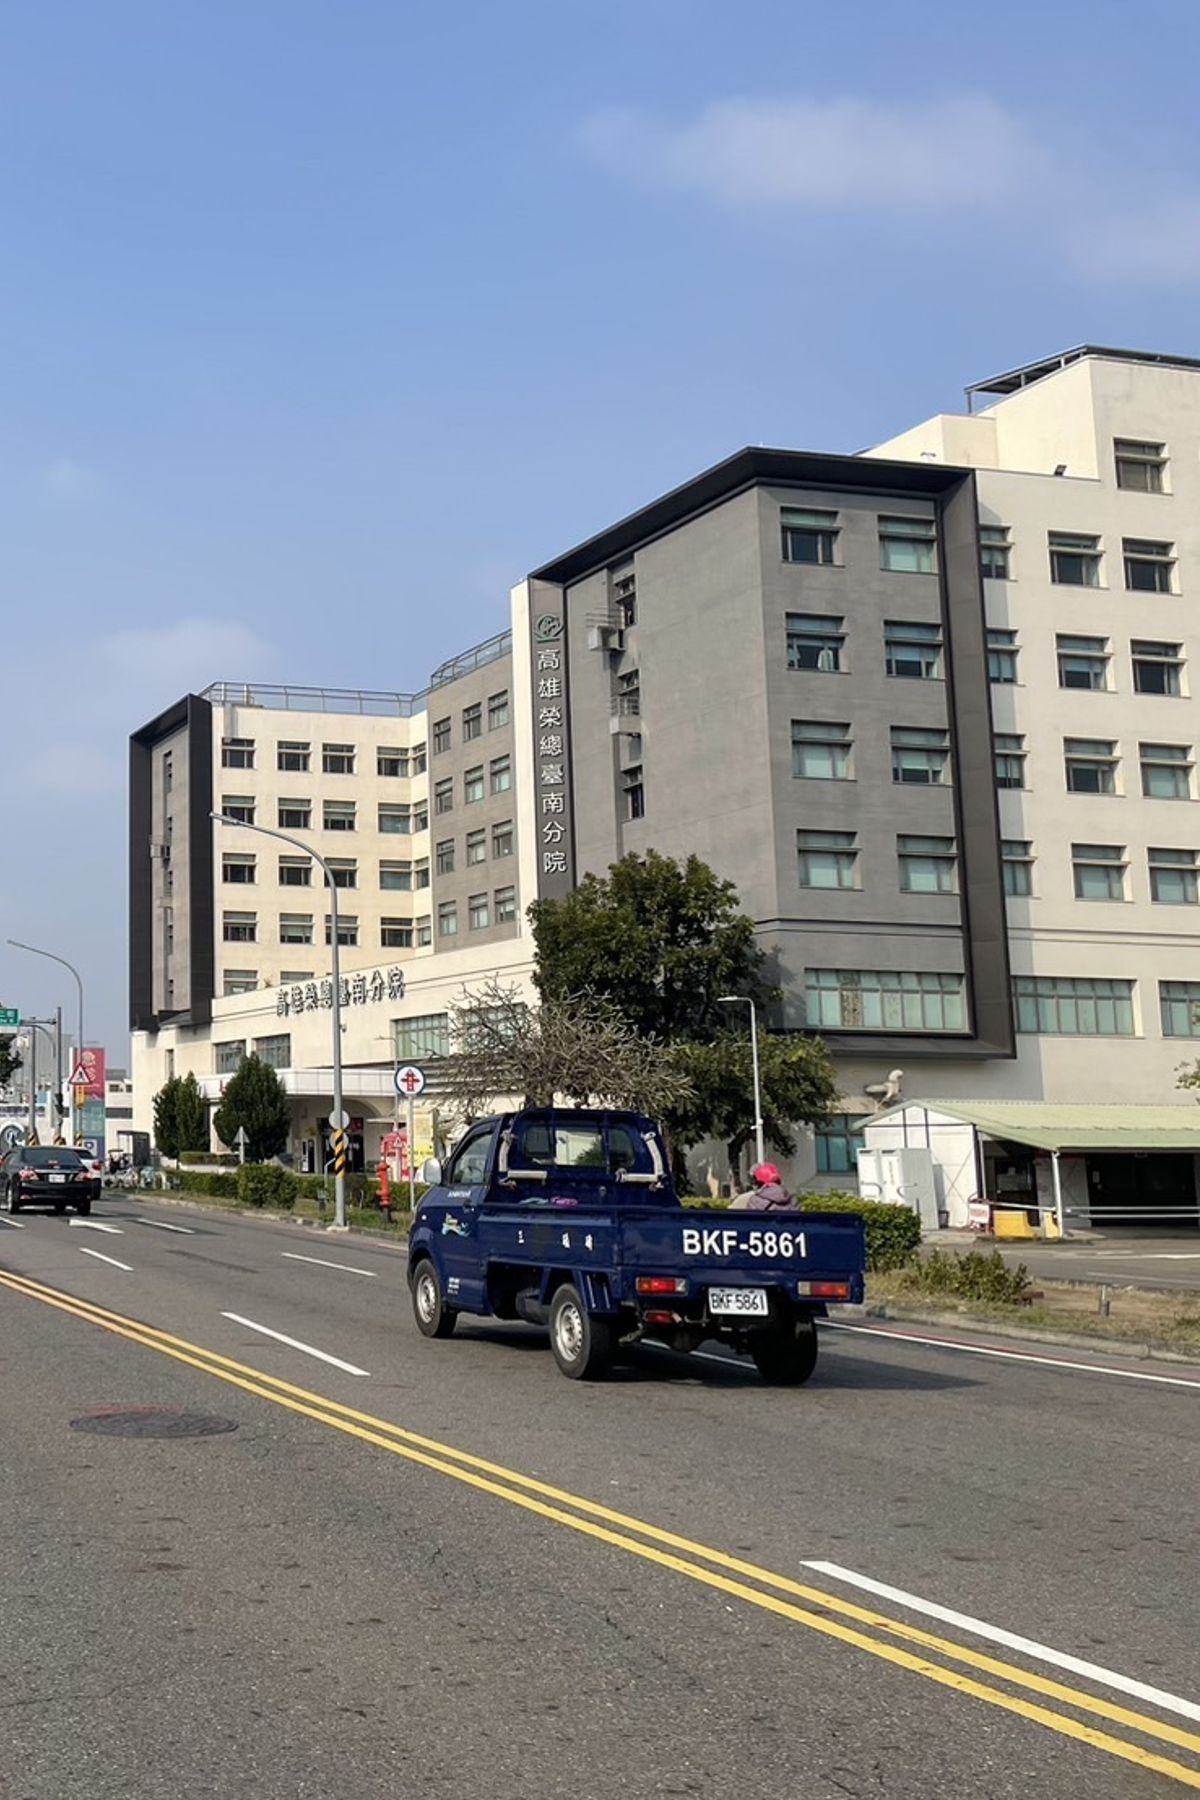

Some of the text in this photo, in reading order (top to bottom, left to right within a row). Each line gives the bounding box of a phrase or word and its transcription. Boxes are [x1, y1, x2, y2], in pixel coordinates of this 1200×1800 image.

[537, 649, 567, 874] 高雄榮總臺南分院
[682, 1229, 807, 1258] BKF-5861
